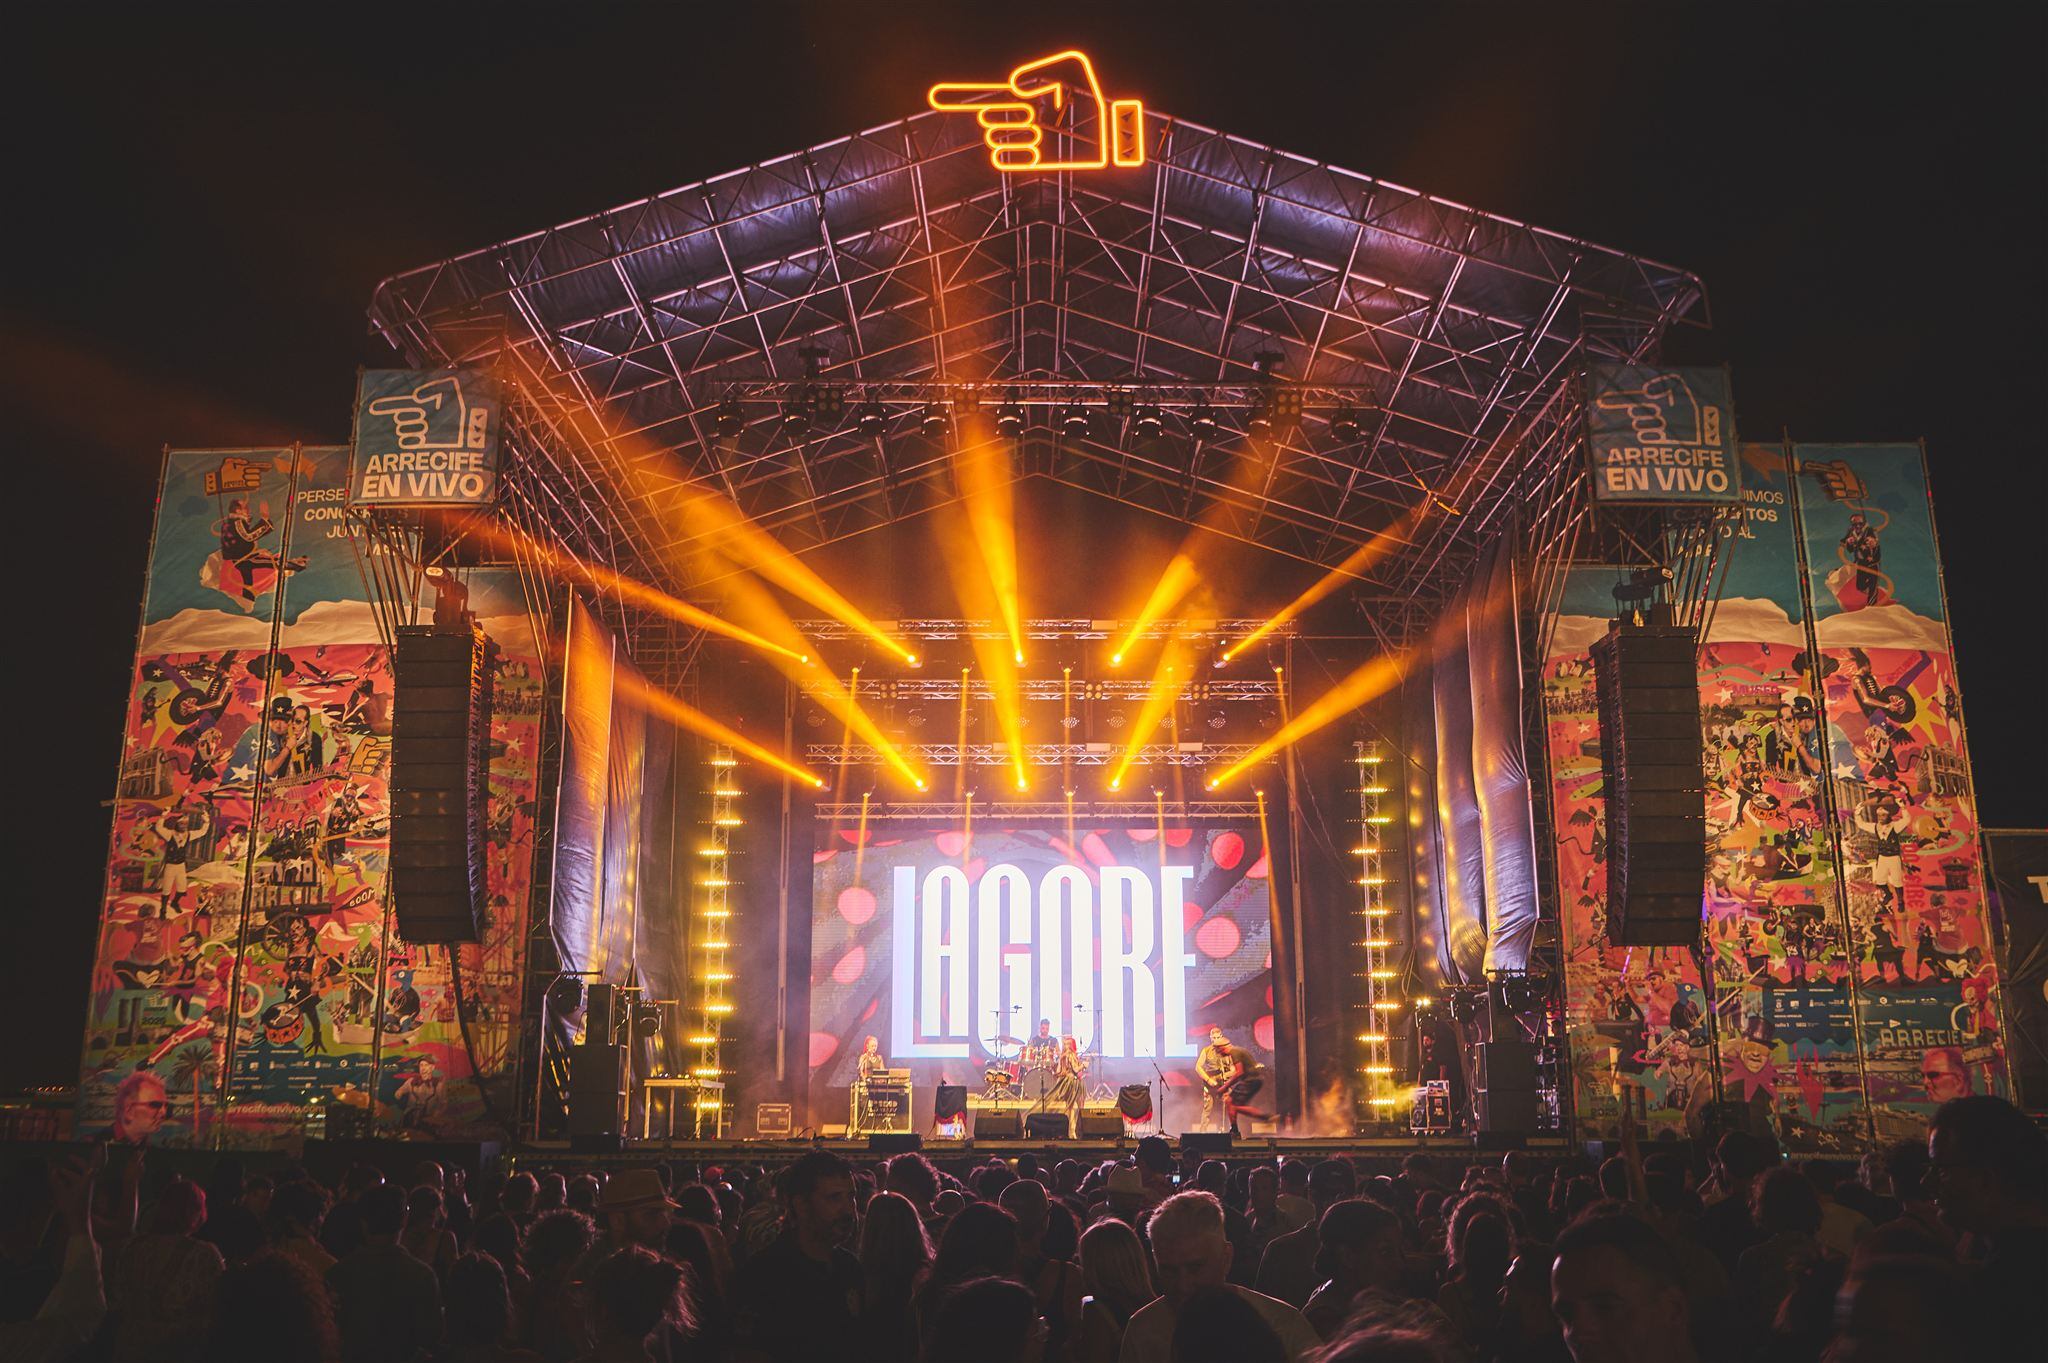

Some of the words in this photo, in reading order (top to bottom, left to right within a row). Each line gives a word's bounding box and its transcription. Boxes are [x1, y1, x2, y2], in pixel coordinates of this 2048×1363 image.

[366, 452, 484, 474] ARRECIFE
[1606, 447, 1725, 468] ARRECIFE
[361, 473, 401, 499] EN
[407, 473, 484, 498] VIVO
[1606, 467, 1649, 492] EN
[1653, 467, 1729, 493] VIVO
[297, 488, 346, 504] PERSE
[891, 864, 1198, 1058] LAGORE
